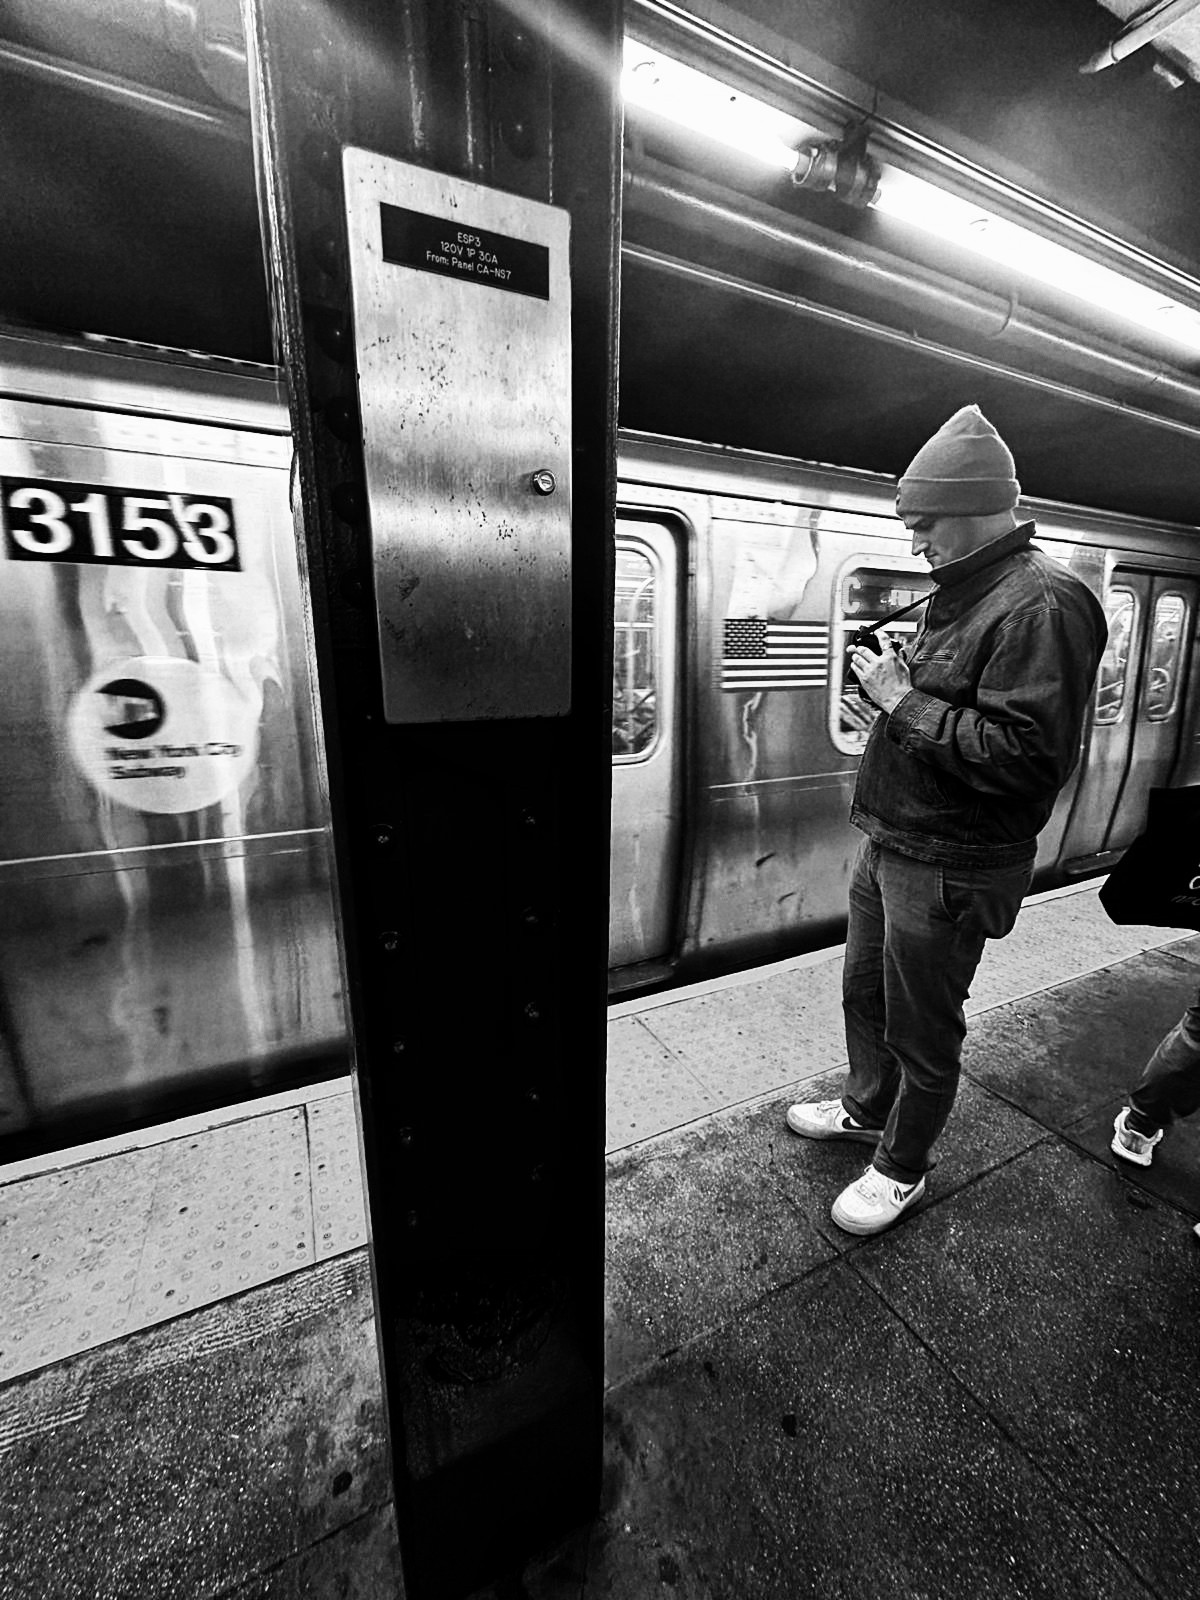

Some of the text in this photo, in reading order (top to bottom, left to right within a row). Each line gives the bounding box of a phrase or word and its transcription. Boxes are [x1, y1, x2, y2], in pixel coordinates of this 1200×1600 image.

[440, 241, 499, 264] 120V 1P 30A
[457, 231, 481, 248] ESP3
[426, 250, 512, 280] From: Panel CA-NS7
[9, 487, 236, 564] 3153
